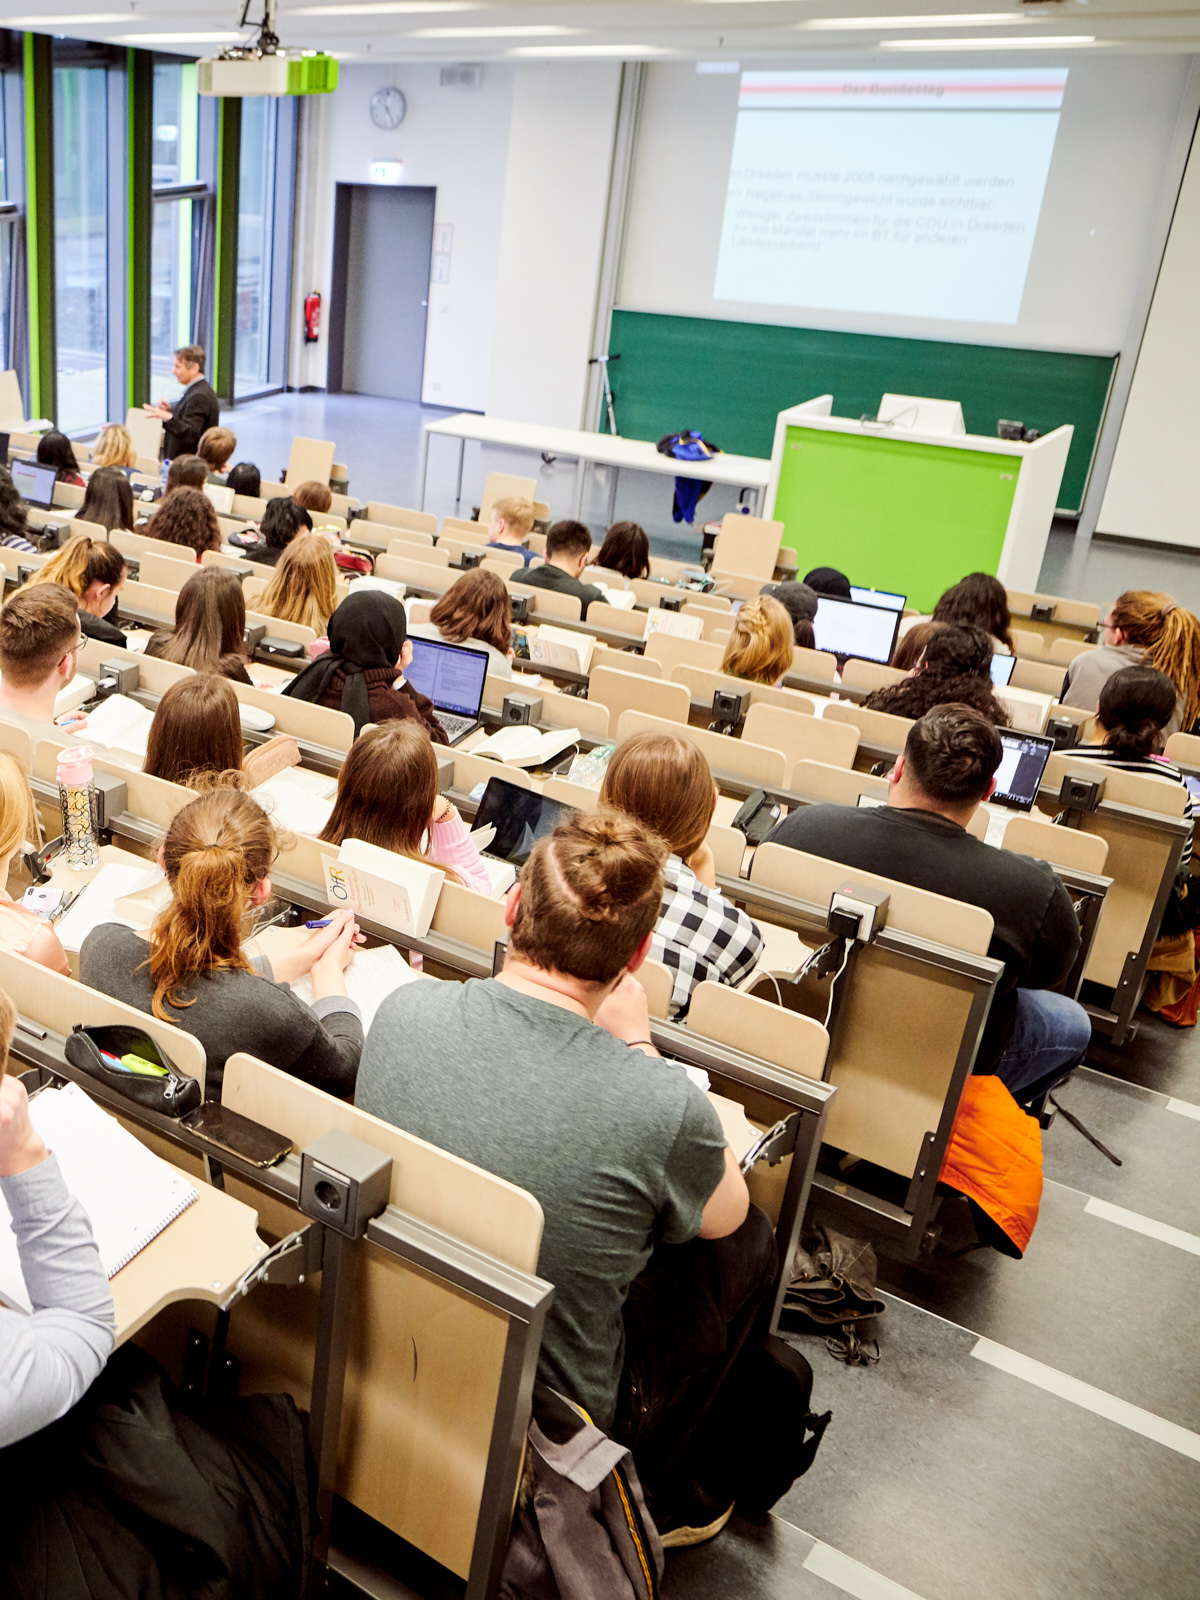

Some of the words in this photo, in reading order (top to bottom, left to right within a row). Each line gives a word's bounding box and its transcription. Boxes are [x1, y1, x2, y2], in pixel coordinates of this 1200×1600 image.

[870, 83, 945, 97] Bundestag
[744, 168, 794, 179] Dresden
[797, 172, 840, 182] musste
[878, 173, 960, 189] nachgewählt
[807, 191, 893, 207] Stimmgewicht
[896, 195, 935, 207] wurde
[736, 208, 782, 223] Weniger
[893, 215, 912, 227] die
[916, 216, 947, 229] CDU
[968, 220, 1025, 234] Dresden
[731, 238, 820, 252] Landesverband
[773, 225, 816, 237] Mandat
[914, 234, 967, 246] anderen
[329, 866, 348, 900] ÖfR
